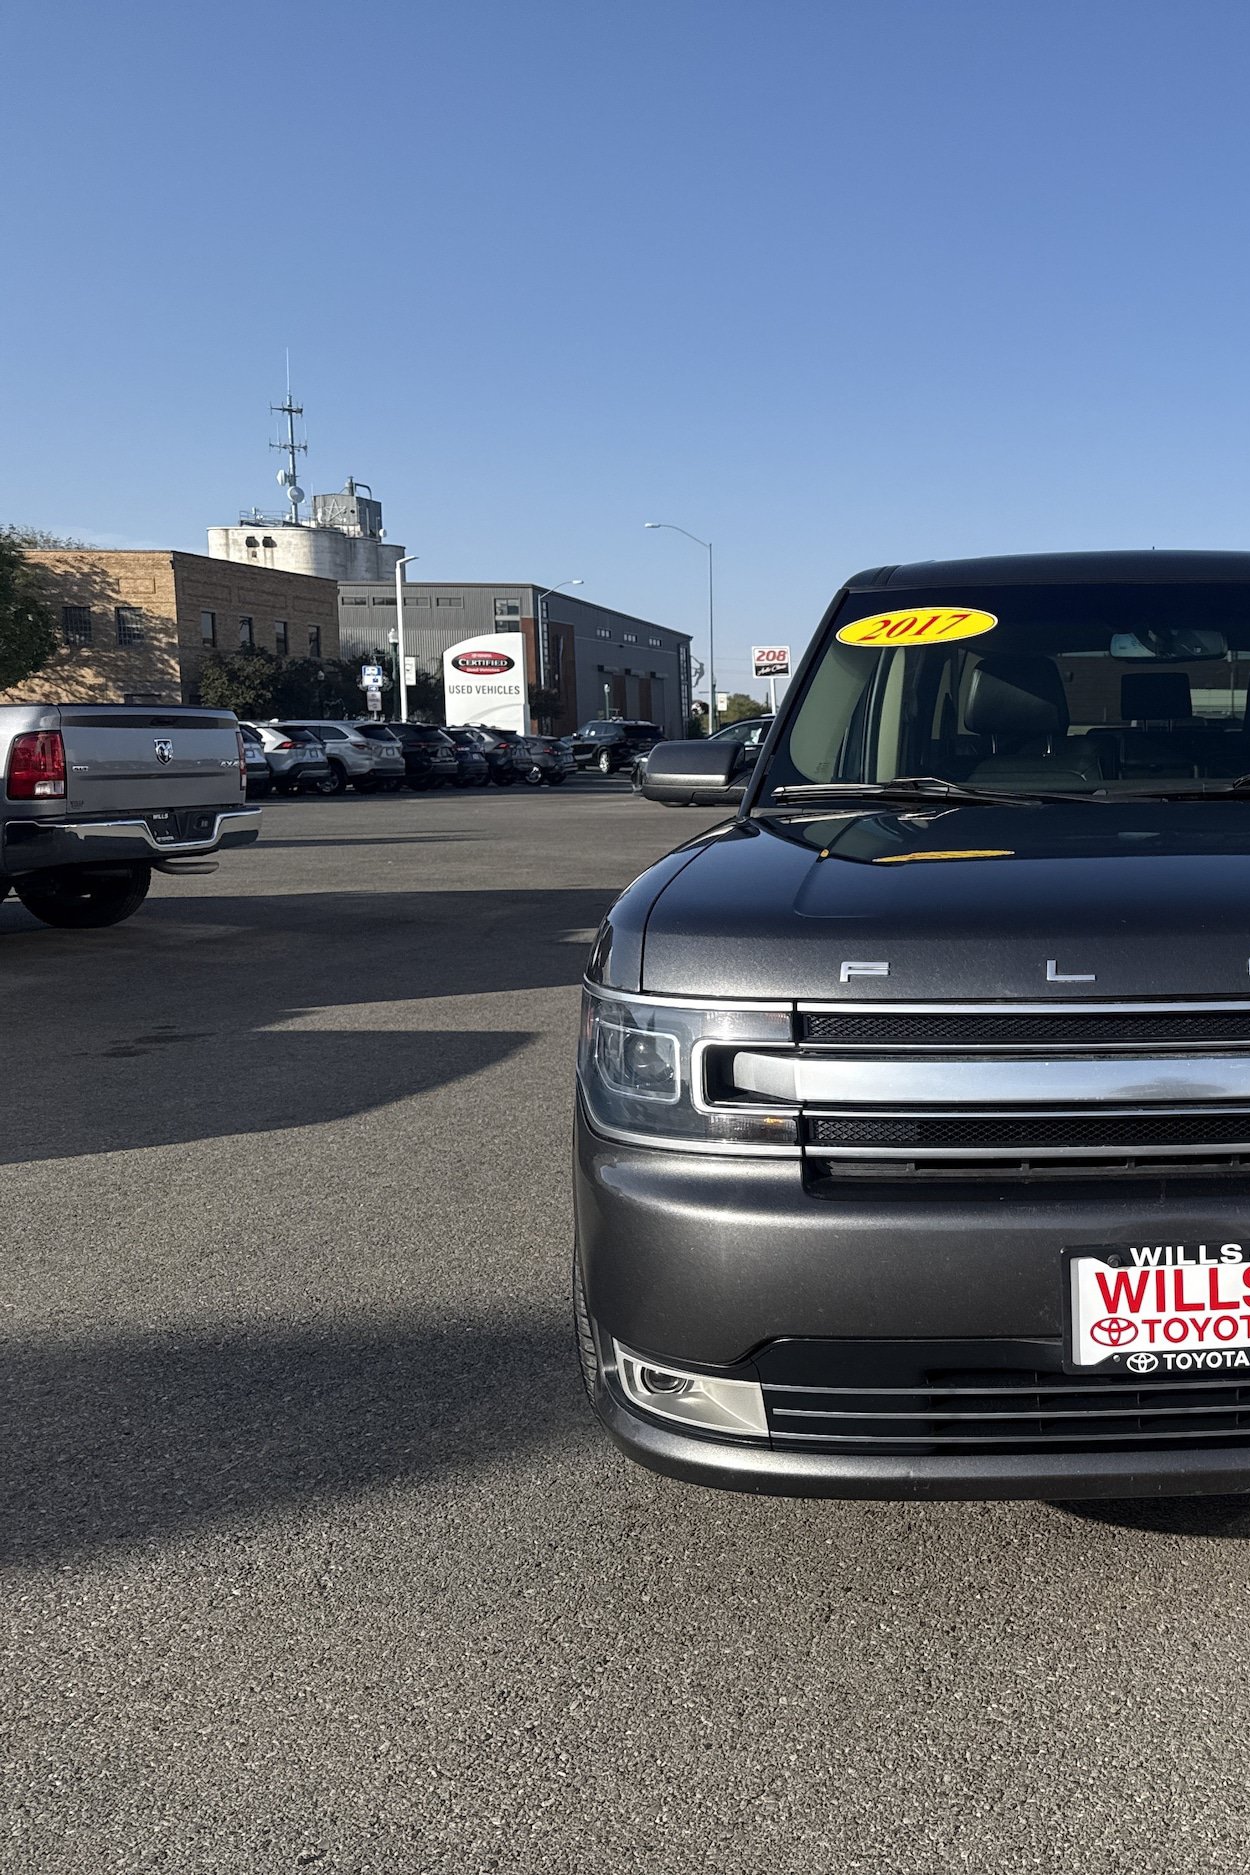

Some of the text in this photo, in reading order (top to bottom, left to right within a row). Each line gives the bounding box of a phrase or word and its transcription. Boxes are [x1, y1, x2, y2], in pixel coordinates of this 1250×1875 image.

[856, 613, 972, 642] 2017
[458, 658, 508, 667] CERTIFIED
[756, 650, 786, 662] 208
[448, 685, 521, 695] USED VEHICLES
[1130, 1243, 1243, 1267] WILLS
[1163, 1350, 1250, 1370] TOYOTA
